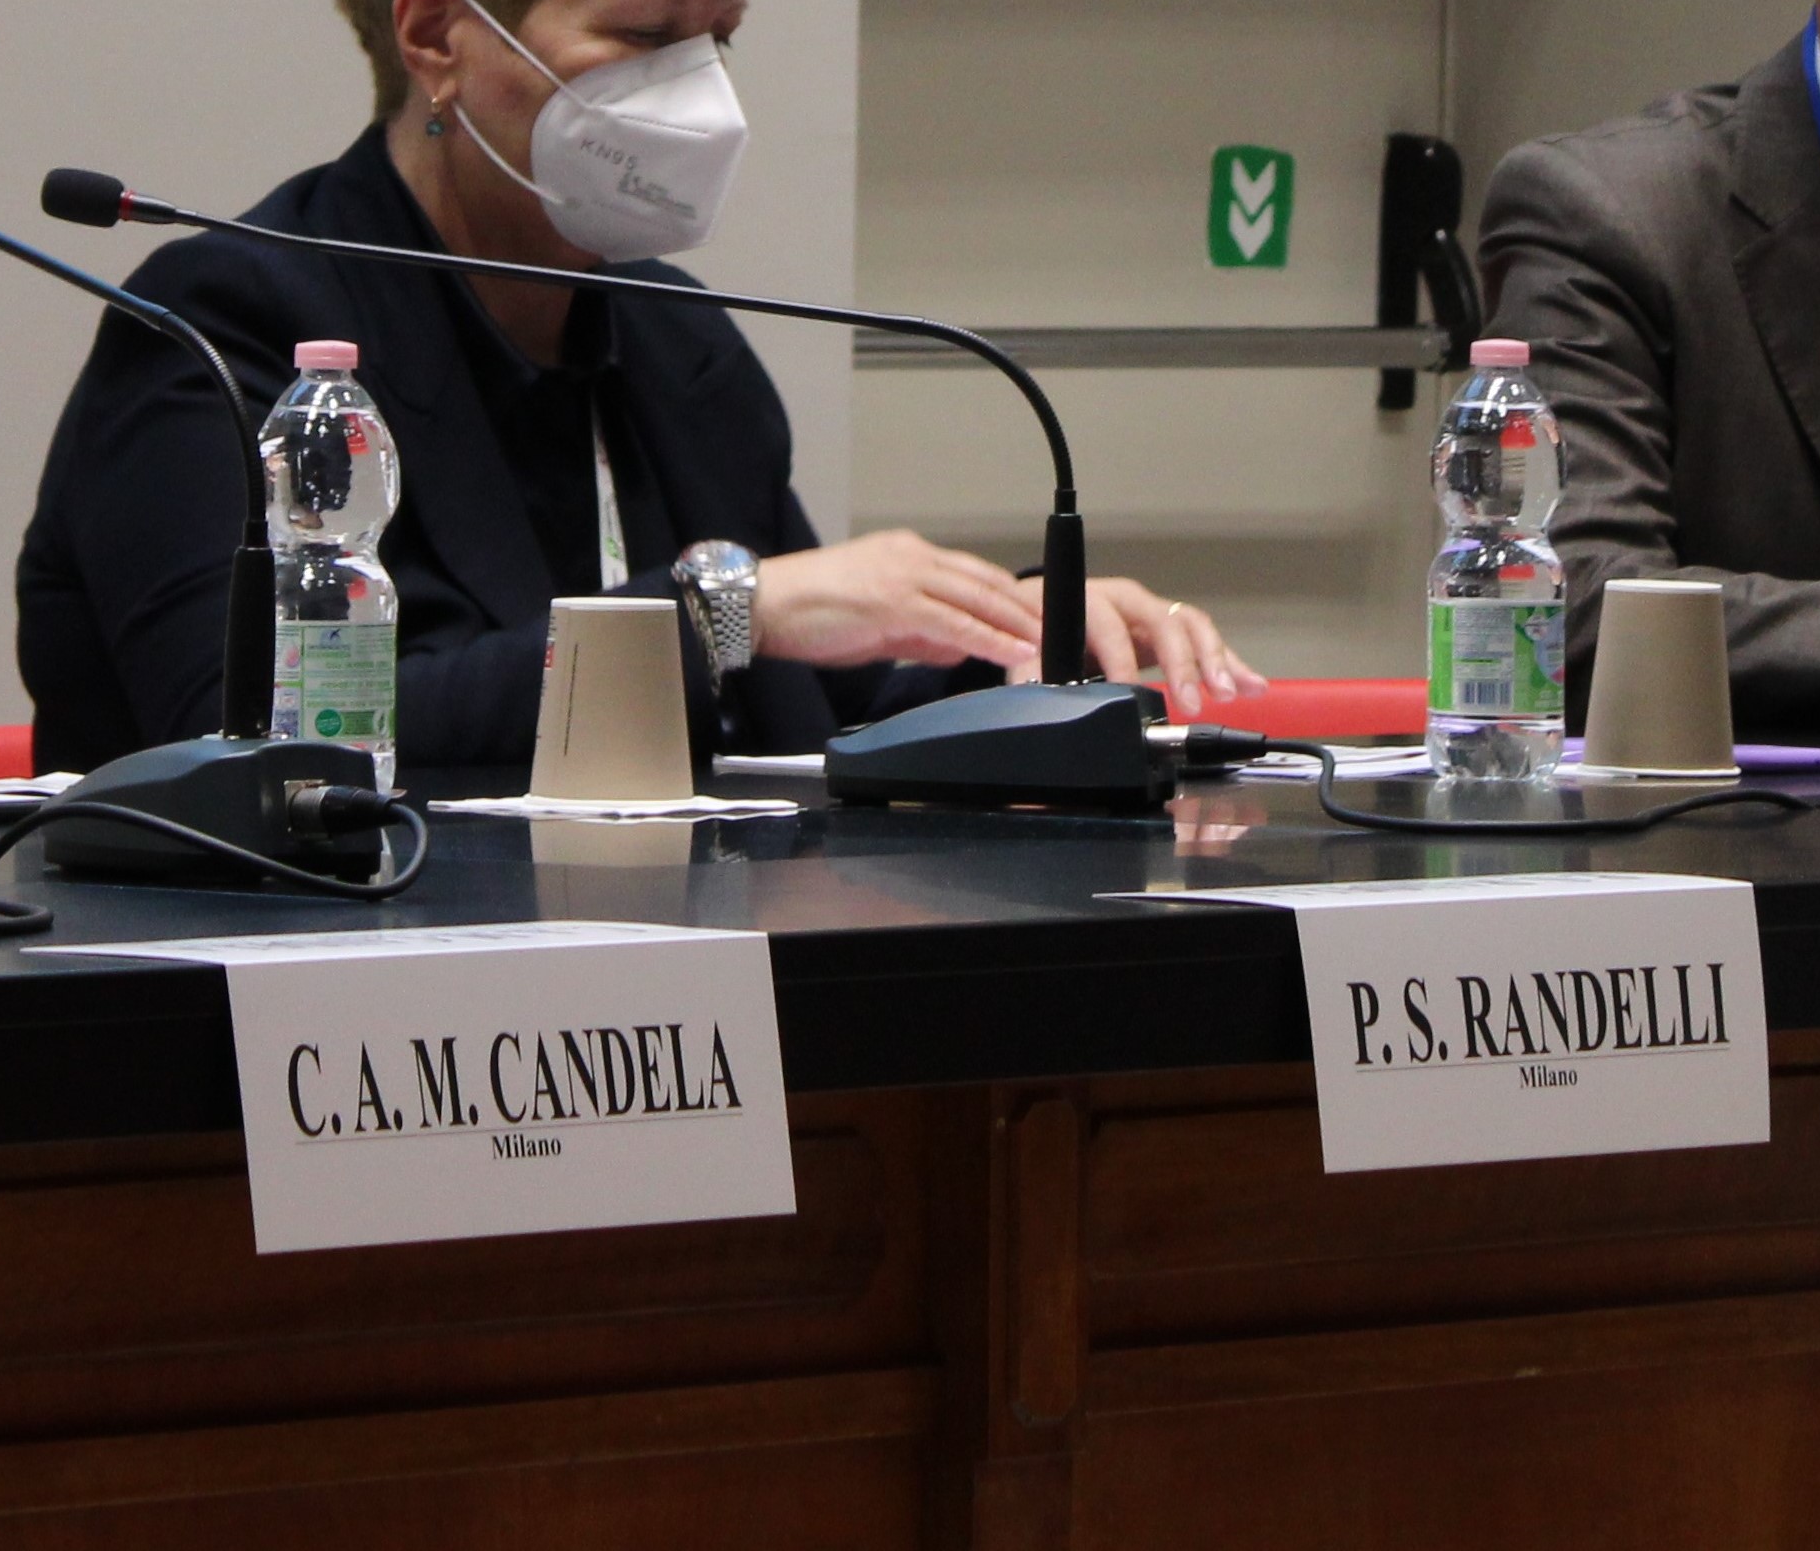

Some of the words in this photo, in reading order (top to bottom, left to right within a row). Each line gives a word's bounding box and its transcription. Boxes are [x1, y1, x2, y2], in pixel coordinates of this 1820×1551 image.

[1346, 982, 1392, 1065] P.
[1402, 977, 1448, 1063] S.
[1457, 963, 1730, 1058] RANDELLI
[288, 1044, 341, 1137] C.
[356, 1042, 404, 1132] A.
[412, 1037, 479, 1128] M.
[488, 1021, 743, 1126] CANDELA
[1519, 1066, 1578, 1088] Milano
[492, 1133, 562, 1160] Milano
